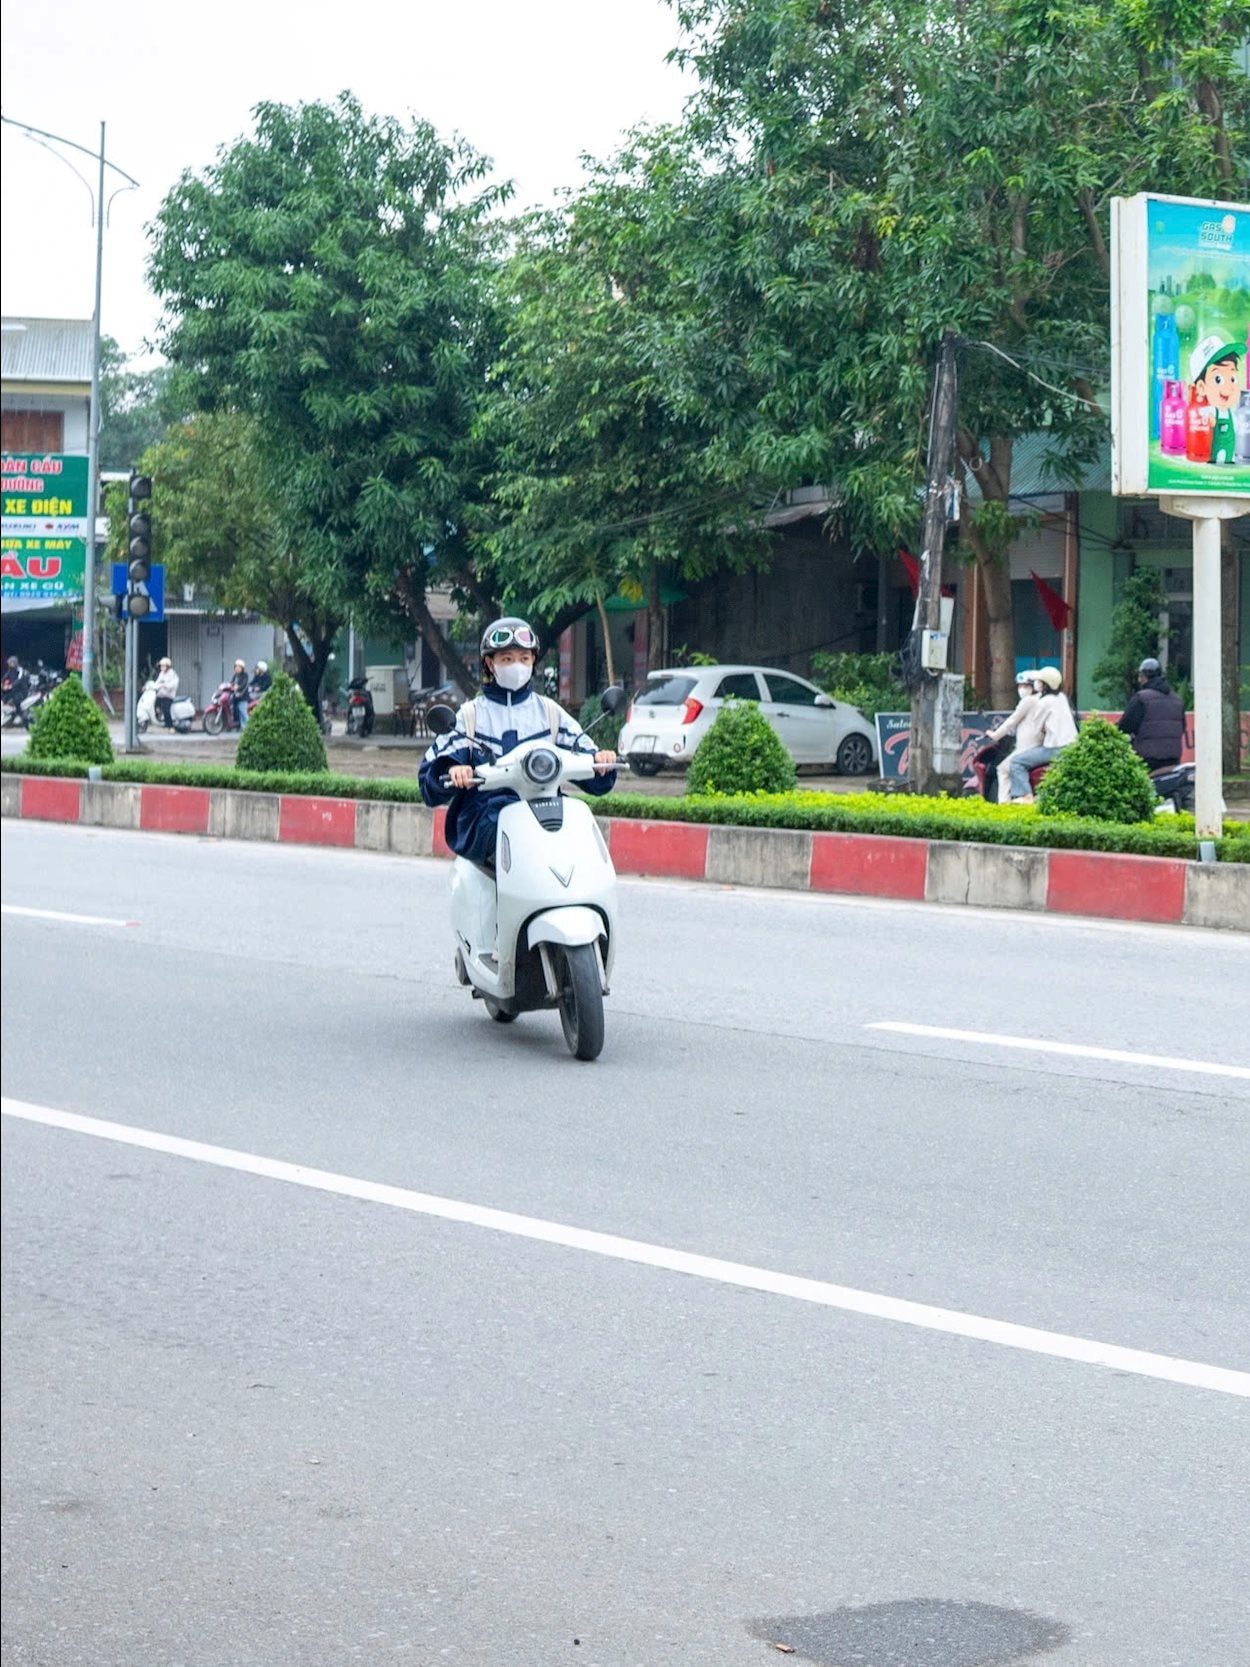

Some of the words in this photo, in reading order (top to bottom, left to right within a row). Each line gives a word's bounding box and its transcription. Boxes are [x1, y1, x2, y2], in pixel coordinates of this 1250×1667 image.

[1202, 221, 1222, 232] GAS
[1200, 231, 1232, 242] SOUTH
[5, 498, 27, 515] XE
[32, 496, 72, 517] ĐIỆN
